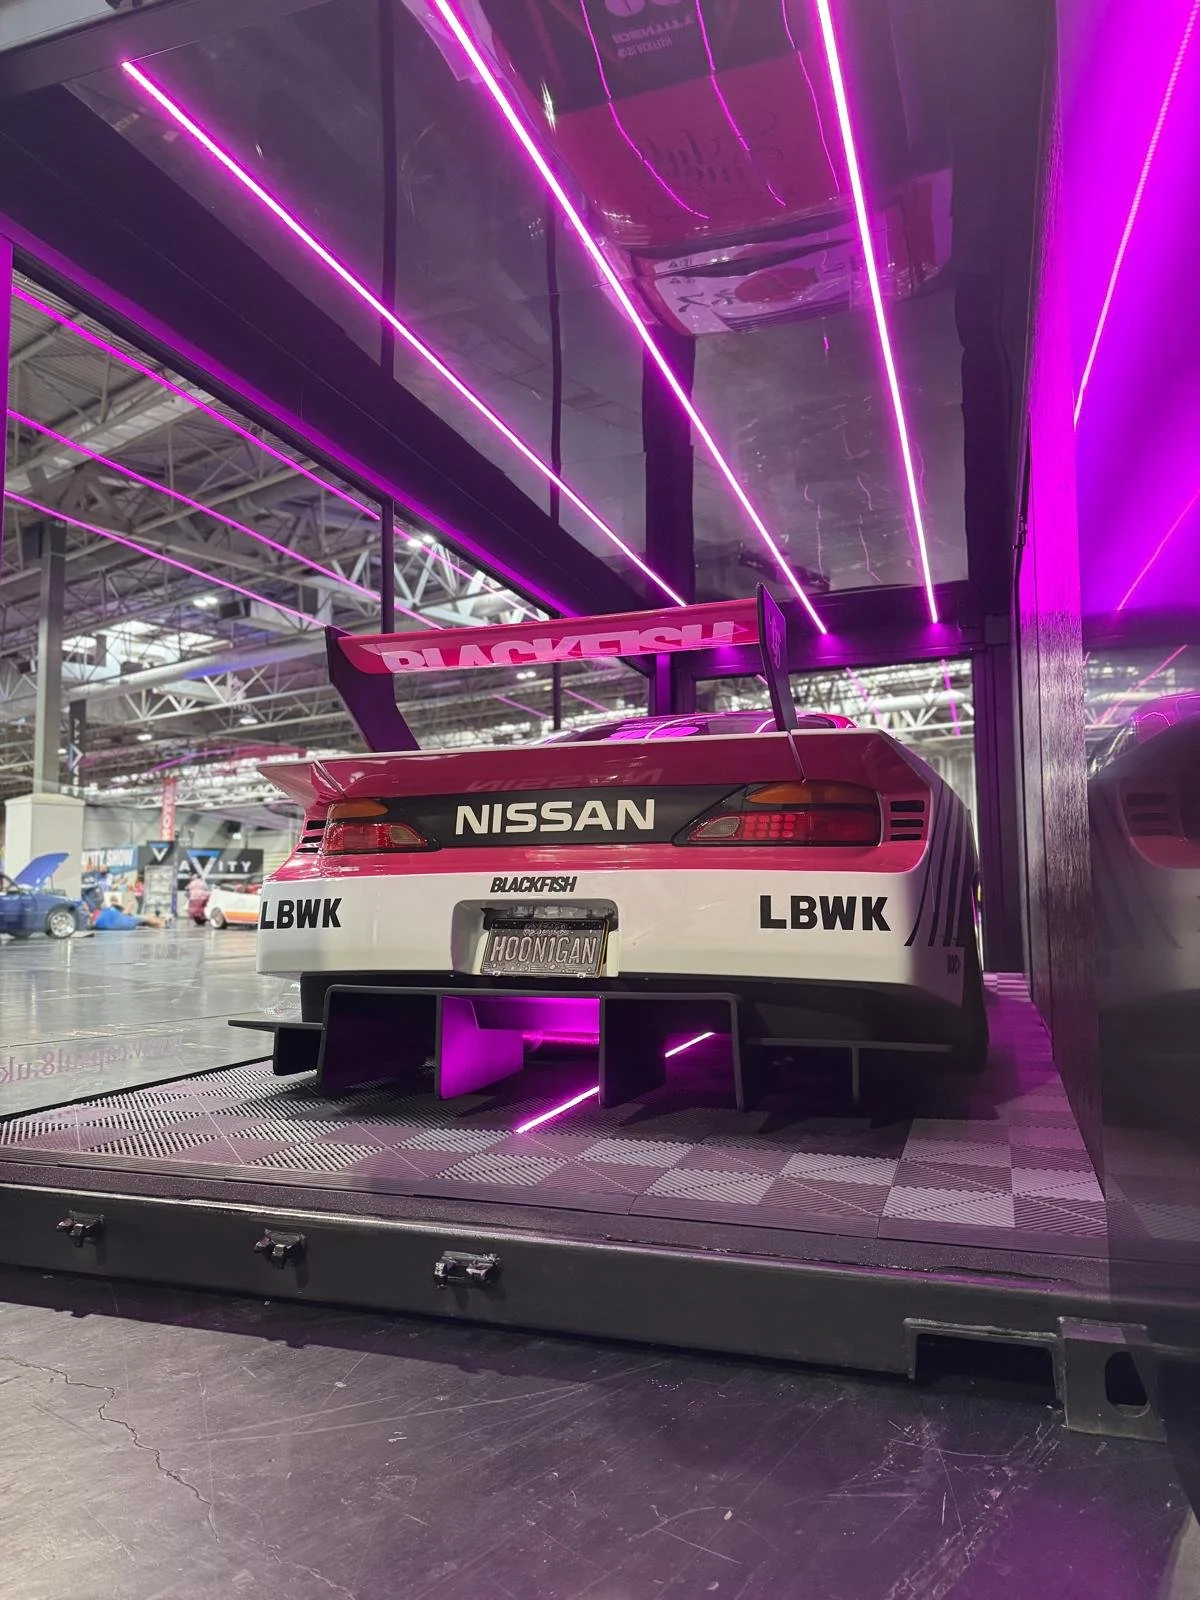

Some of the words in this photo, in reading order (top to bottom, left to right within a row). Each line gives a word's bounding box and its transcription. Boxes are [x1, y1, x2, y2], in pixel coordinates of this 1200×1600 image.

[454, 798, 655, 835] NISSAN
[489, 876, 578, 893] BLACKFISH
[259, 898, 342, 929] LBWK
[759, 895, 891, 931] LBWK
